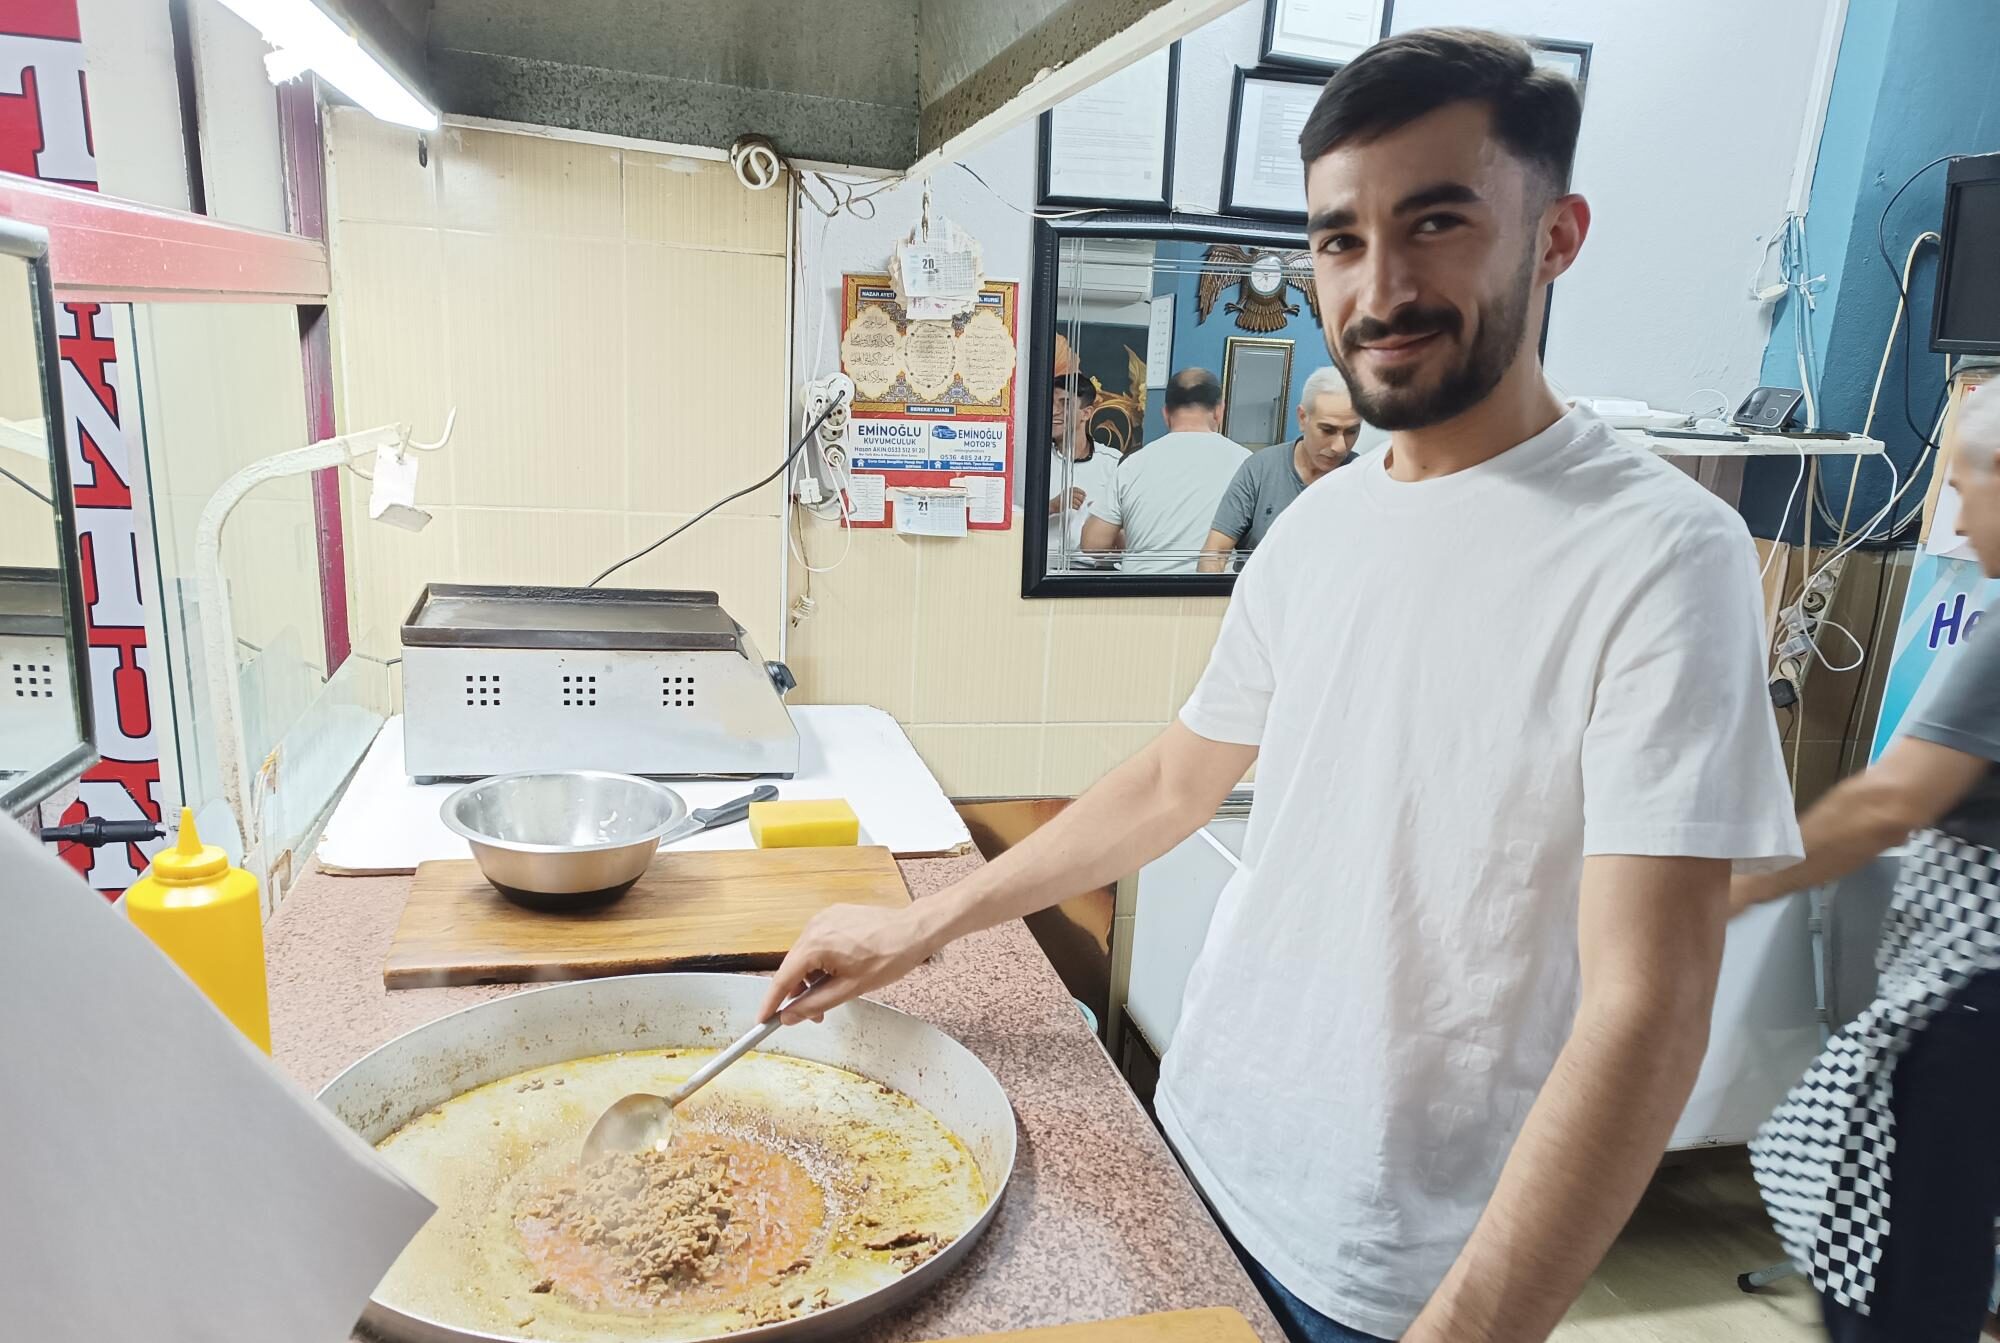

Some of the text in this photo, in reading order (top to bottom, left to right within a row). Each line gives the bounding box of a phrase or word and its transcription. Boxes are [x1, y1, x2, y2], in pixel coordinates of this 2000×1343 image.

[922, 258, 935, 270] 20
[858, 423, 921, 437] EMİNOĞLU
[958, 427, 1003, 440] EMİNOĞLU
[863, 437, 917, 446] KUYUMCULUK
[963, 440, 997, 448] MOTOR'S
[918, 501, 928, 511] 21
